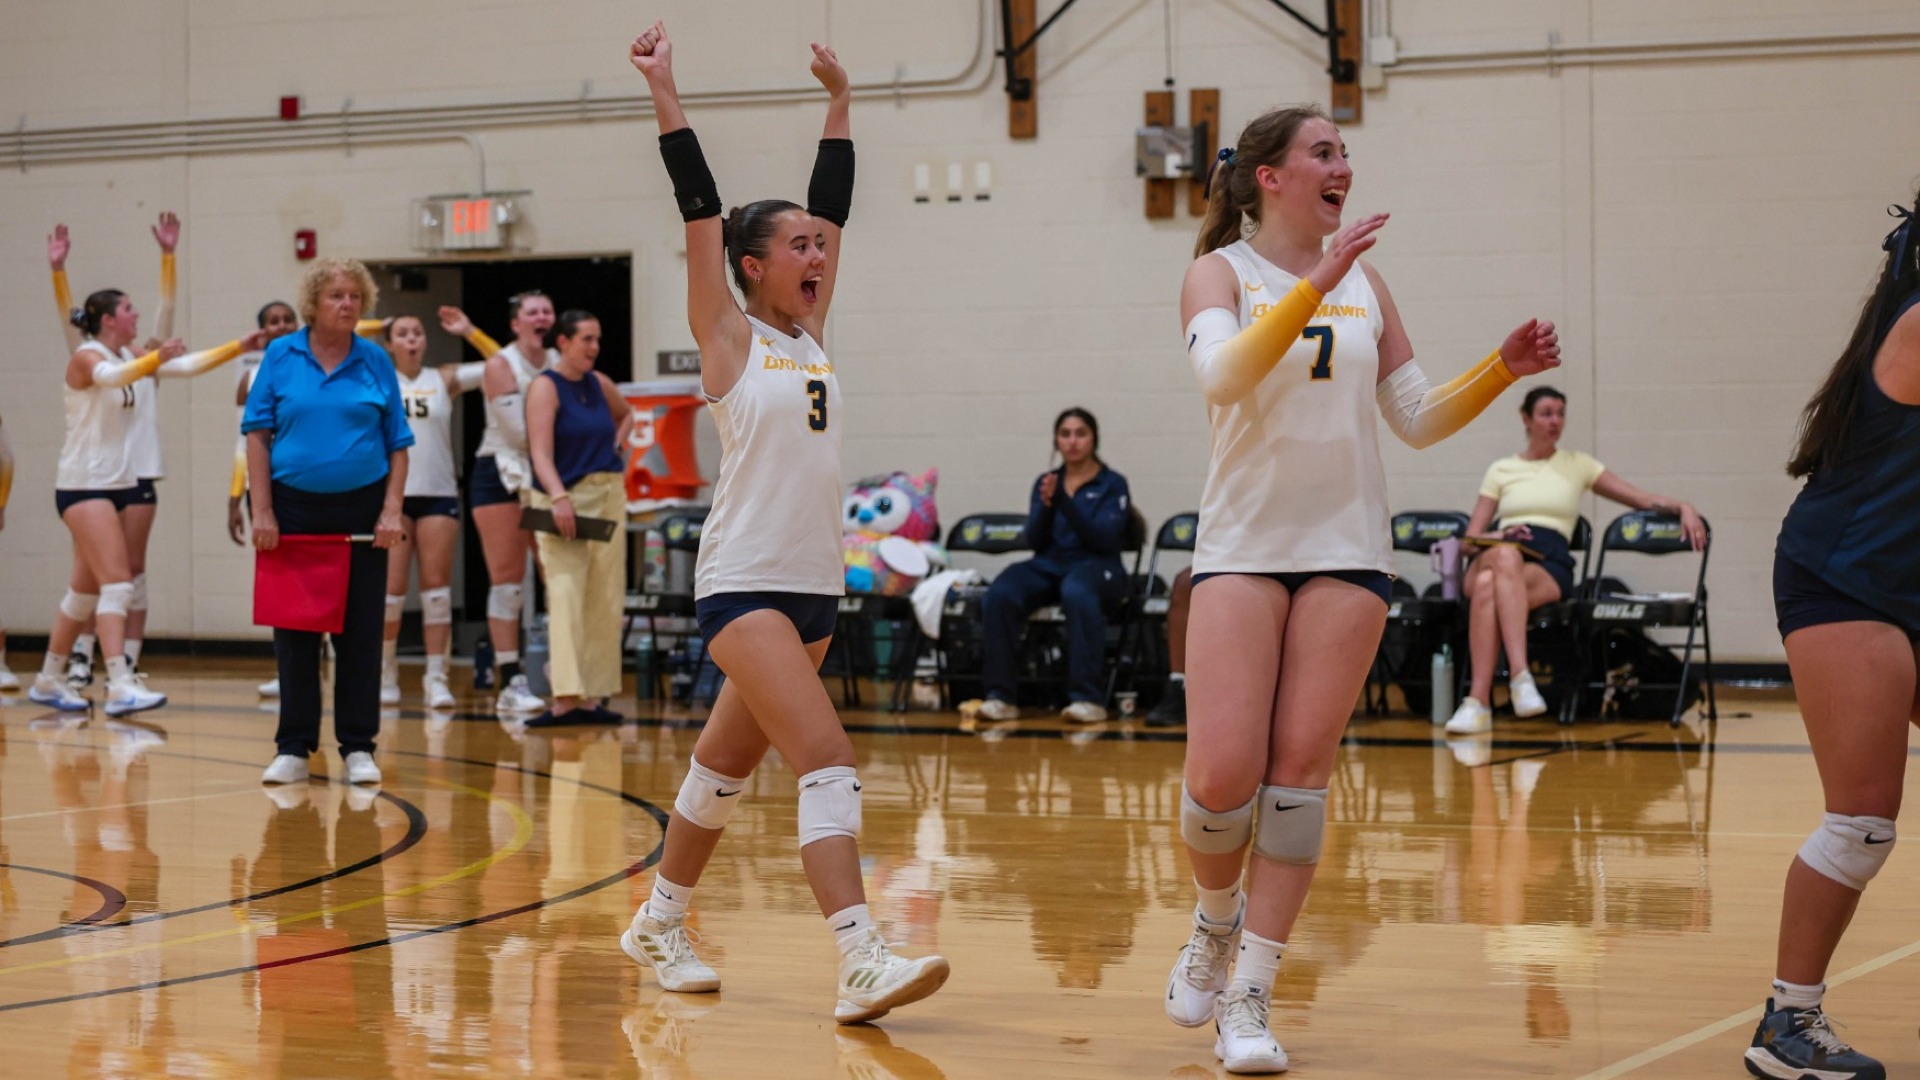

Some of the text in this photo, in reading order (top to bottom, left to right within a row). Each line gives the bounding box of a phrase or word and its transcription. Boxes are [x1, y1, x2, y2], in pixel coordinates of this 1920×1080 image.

[452, 199, 490, 234] EXIT
[1300, 324, 1335, 381] 7
[404, 397, 429, 418] 15
[805, 379, 827, 433] 3
[628, 406, 656, 448] G
[1592, 603, 1646, 619] OWLS
